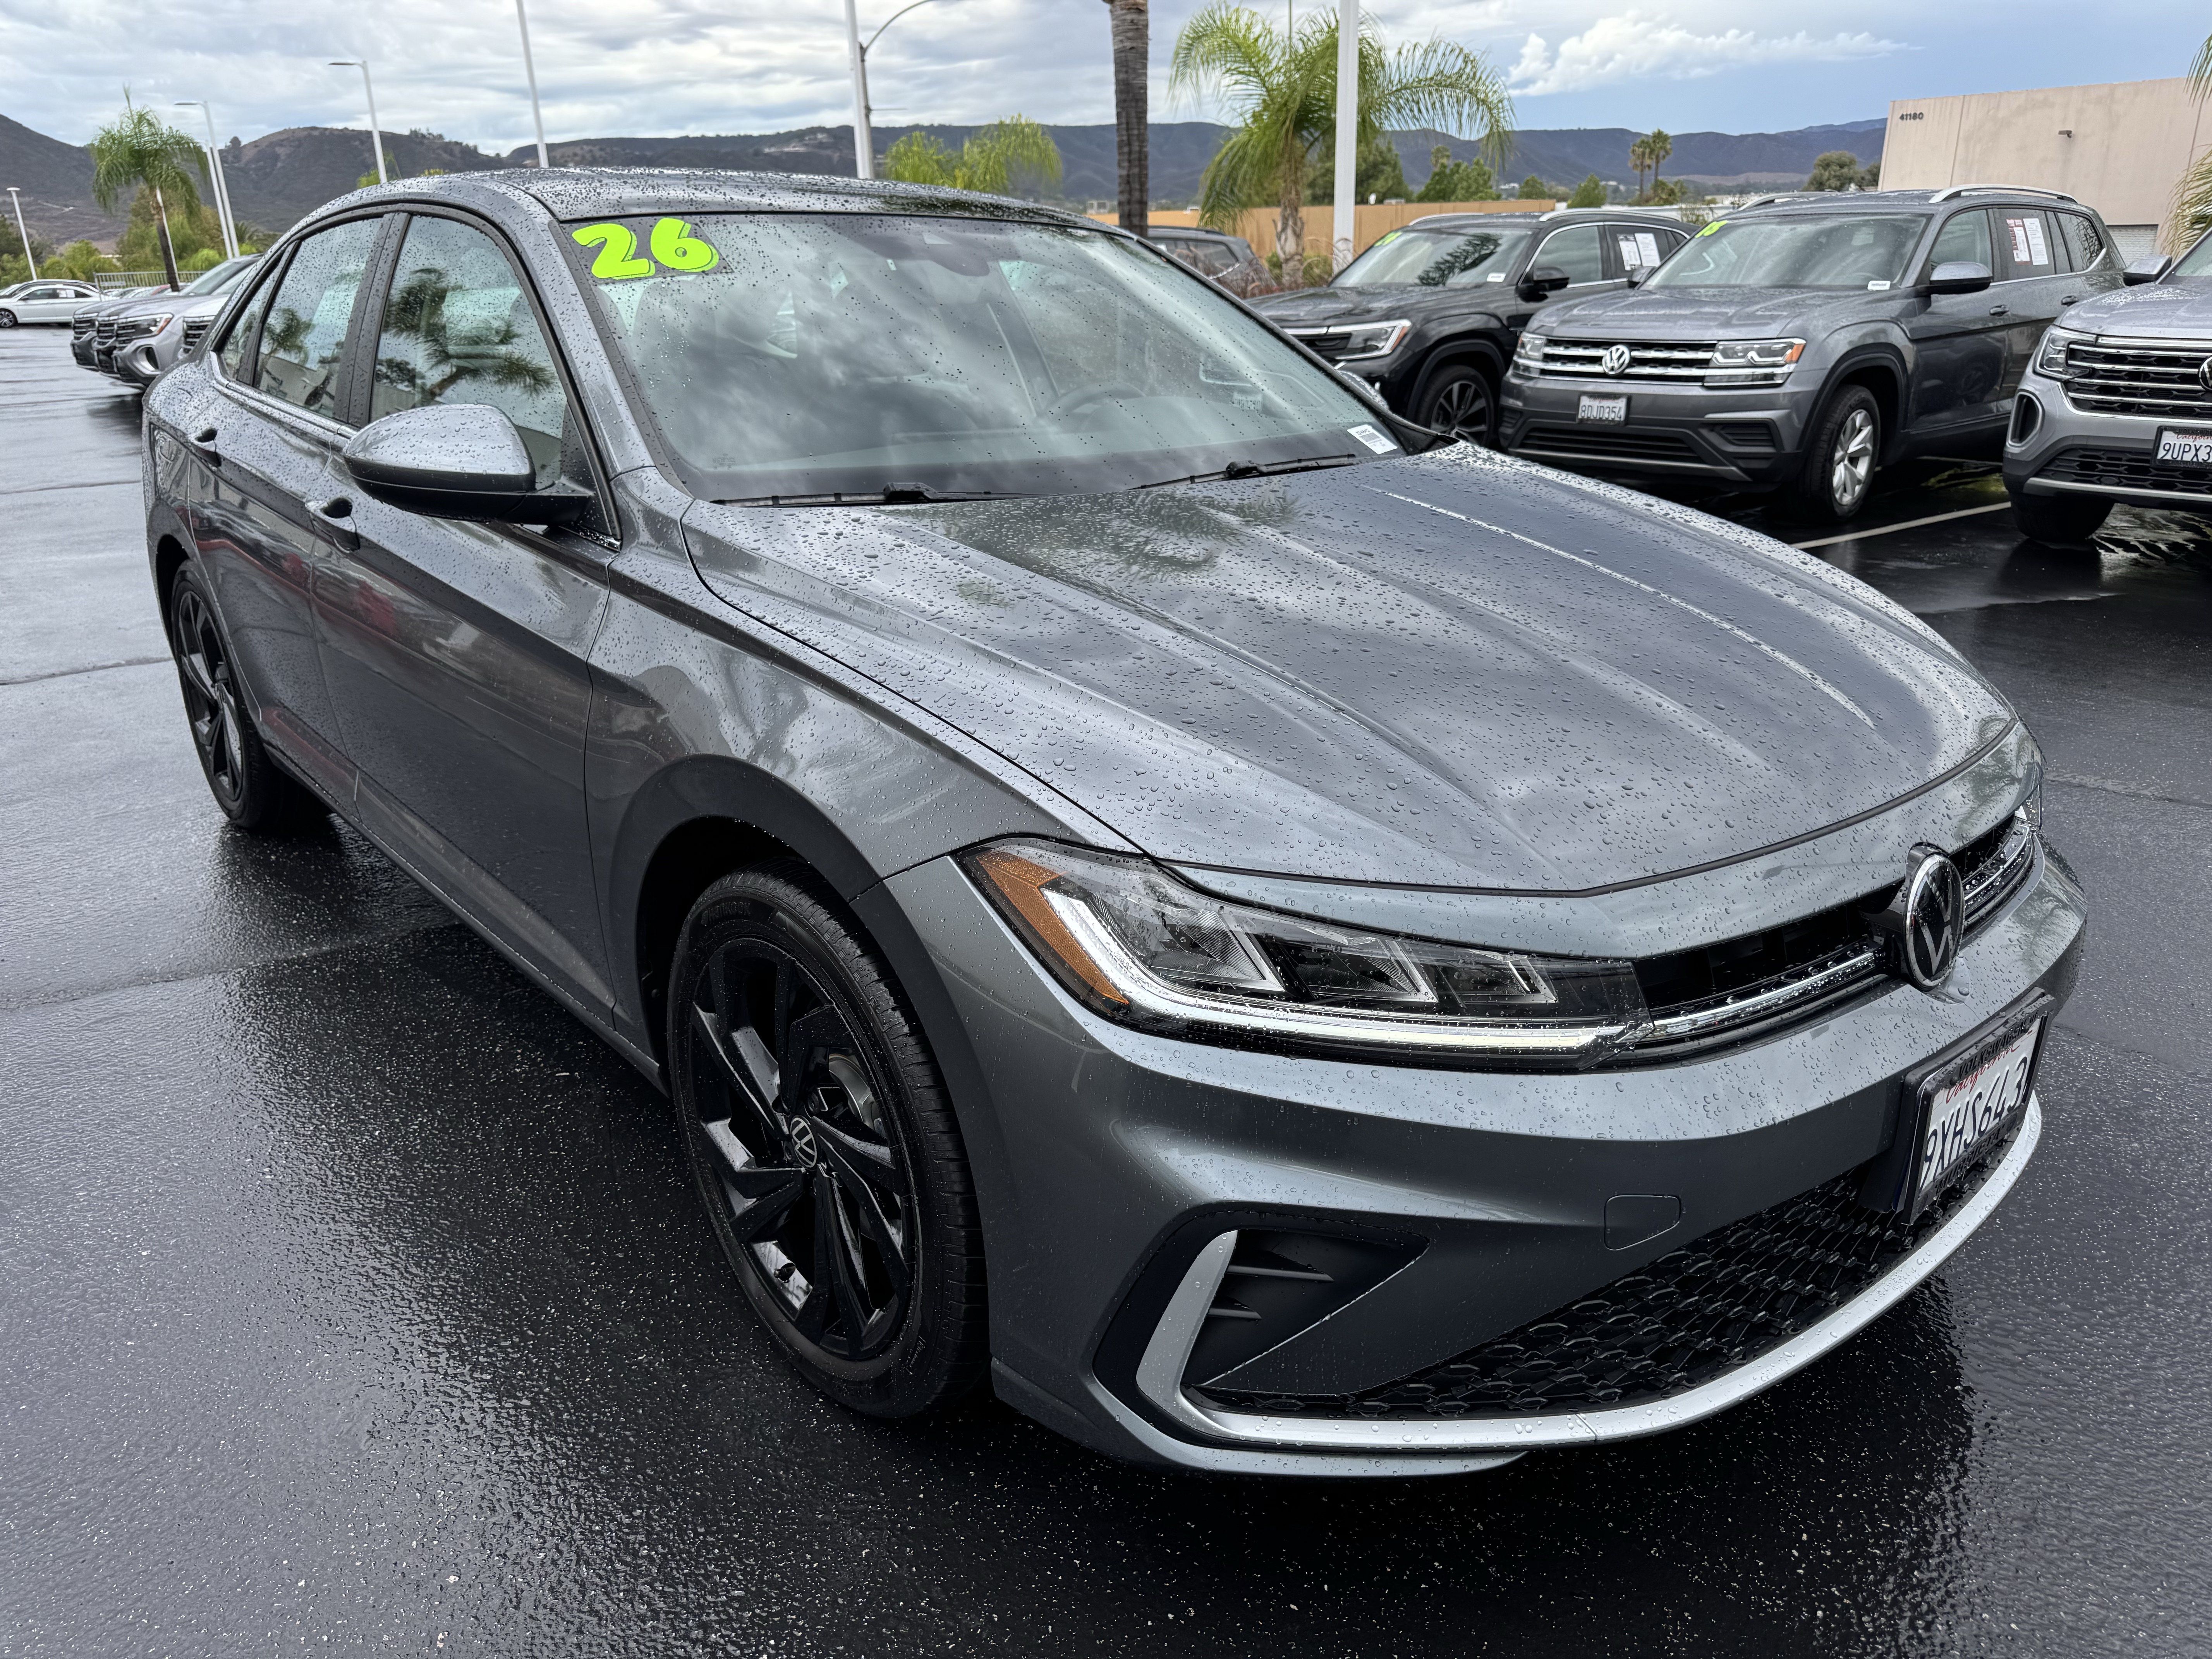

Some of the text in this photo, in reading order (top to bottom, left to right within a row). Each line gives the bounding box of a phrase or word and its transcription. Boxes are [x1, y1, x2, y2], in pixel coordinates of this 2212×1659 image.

[1899, 112, 1924, 121] 41180
[572, 217, 719, 280] 26
[1580, 404, 1622, 421] 8DJD354
[1920, 1056, 2028, 1191] 9XHS643
